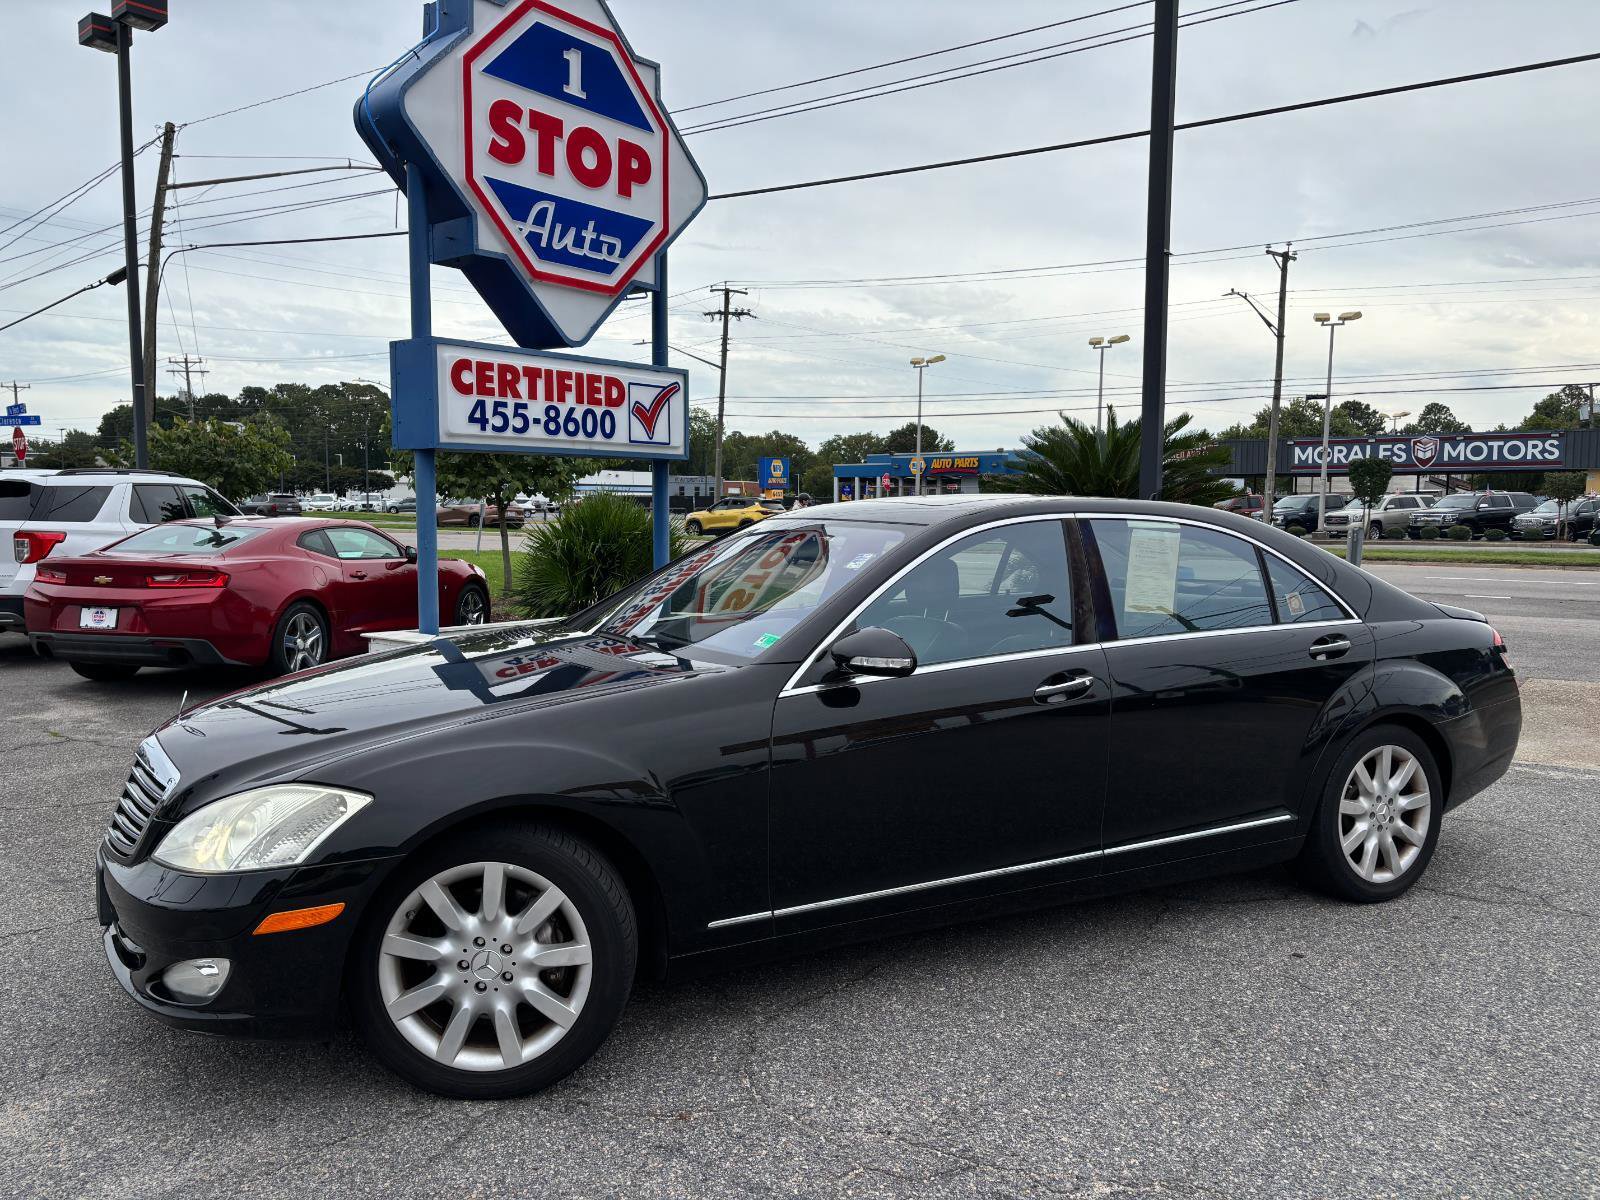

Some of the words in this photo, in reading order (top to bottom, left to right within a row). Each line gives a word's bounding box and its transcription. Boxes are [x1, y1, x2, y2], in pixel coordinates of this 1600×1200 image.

[563, 48, 587, 100] 1
[487, 99, 652, 199] STOP
[516, 201, 625, 262] Auto
[450, 358, 626, 408] CERTIFIED
[467, 399, 617, 439] 455-8600
[931, 458, 953, 469] AUTO
[954, 457, 979, 468] PARTS
[1443, 439, 1560, 462] MOTORS
